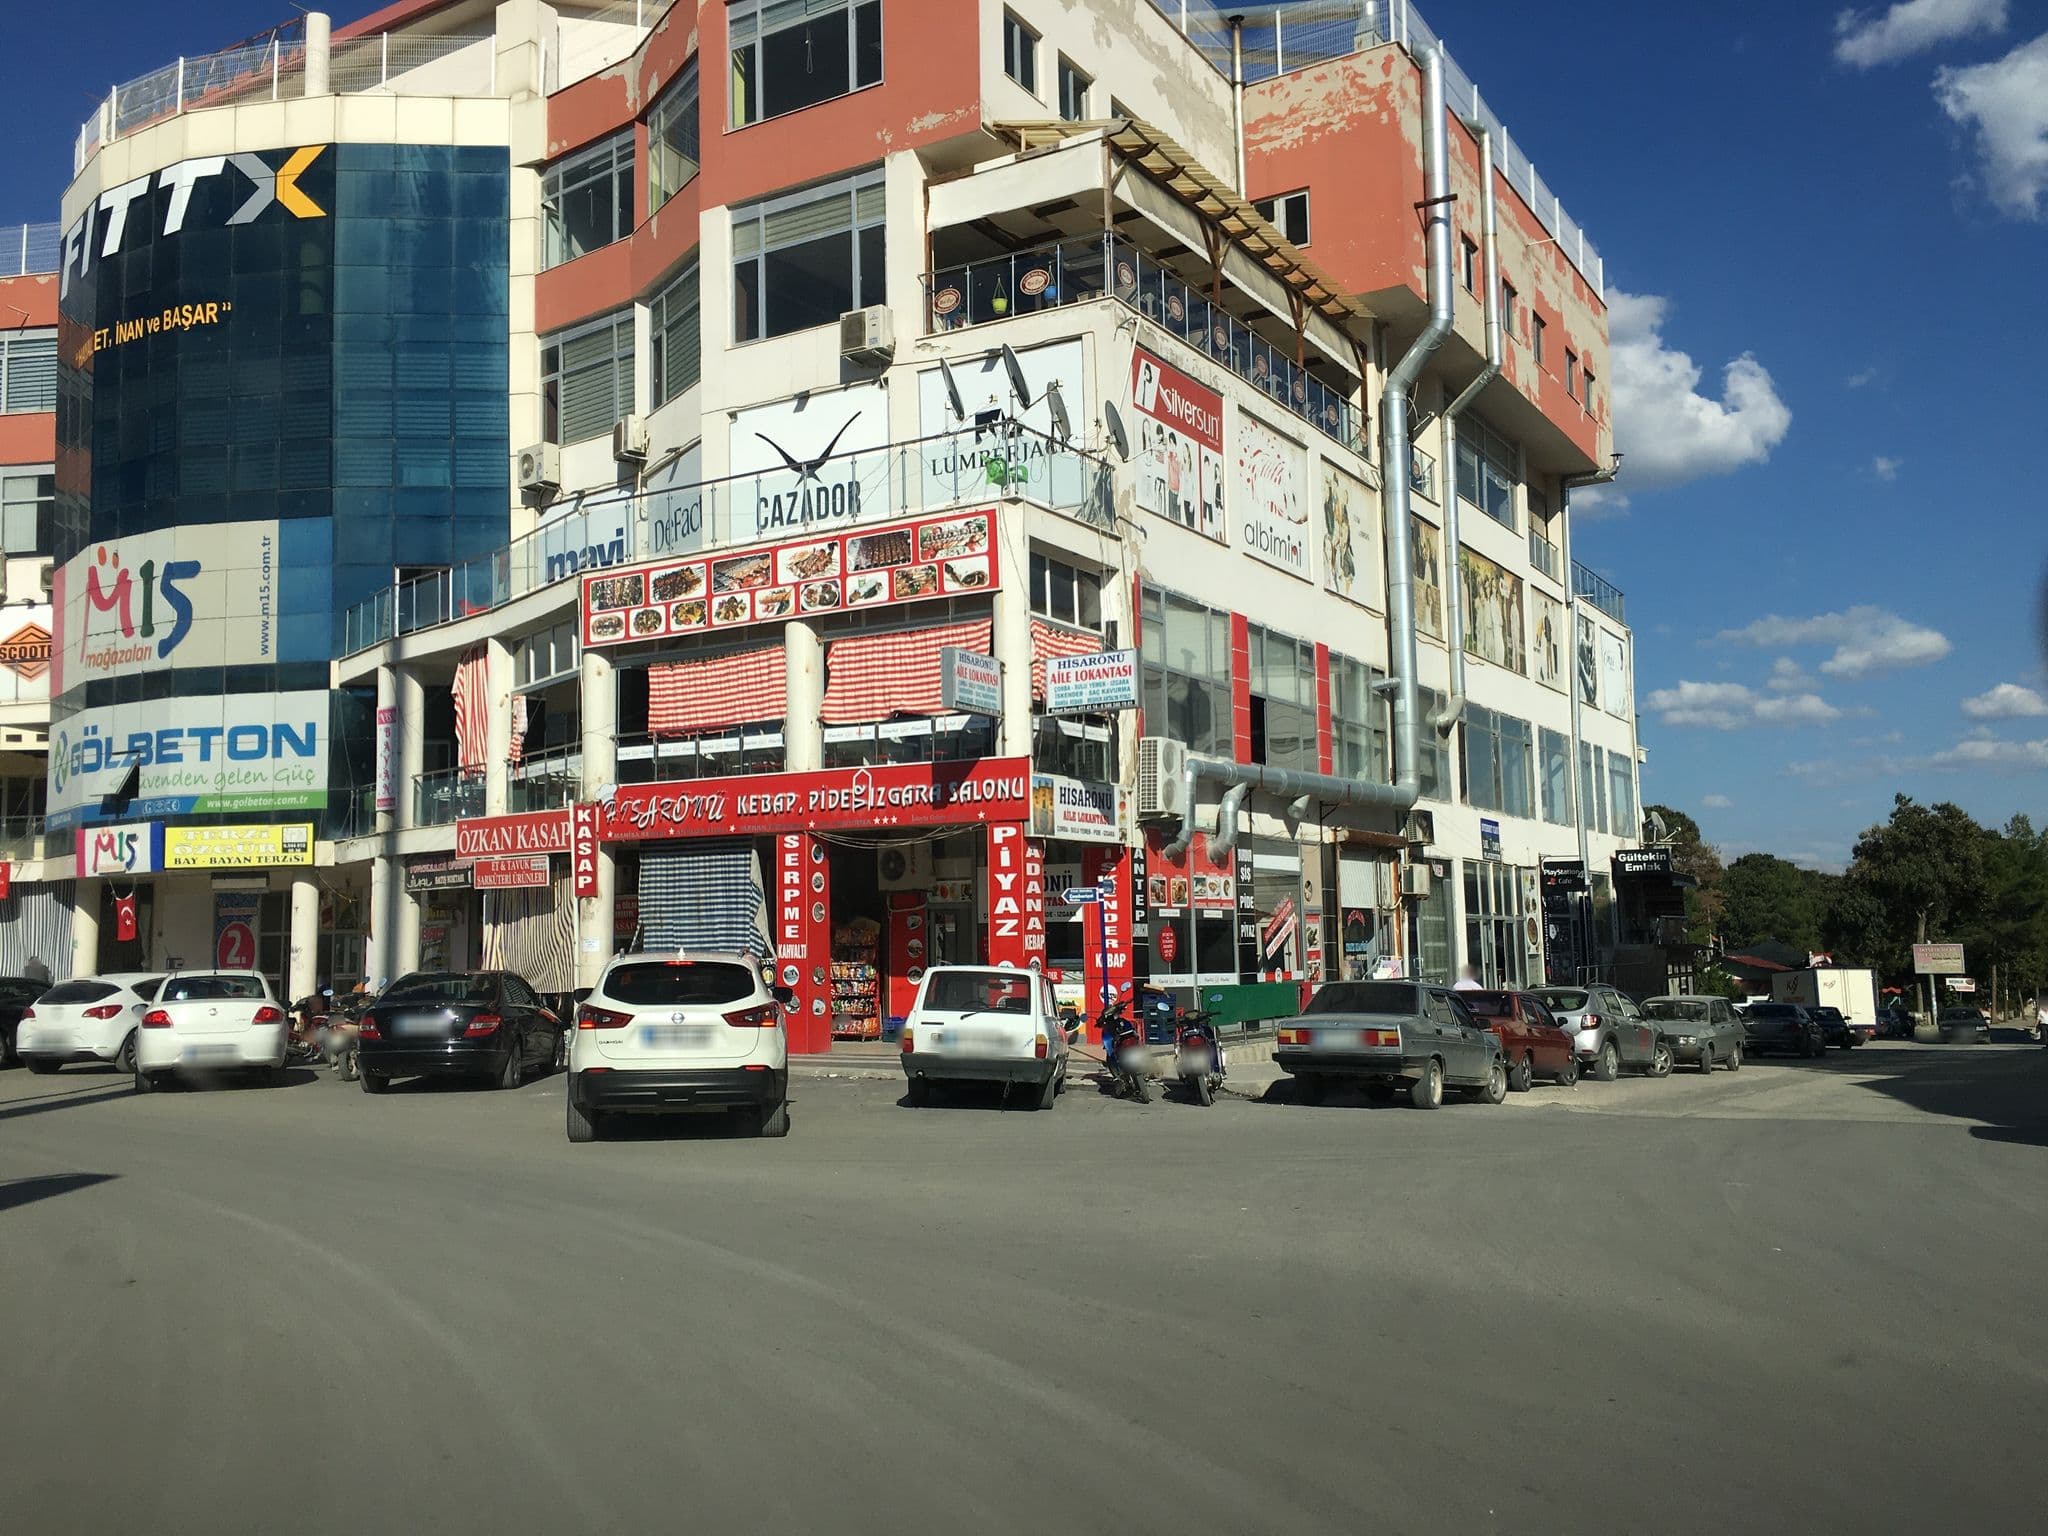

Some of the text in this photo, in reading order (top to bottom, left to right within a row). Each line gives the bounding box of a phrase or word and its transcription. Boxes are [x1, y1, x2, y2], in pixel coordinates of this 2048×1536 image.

[115, 318, 144, 345] İNAN
[147, 317, 160, 334] ve
[163, 302, 218, 331] BAŞAR
[1162, 386, 1219, 441] silversun
[756, 480, 861, 531] CAZADOR
[547, 527, 624, 583] mavi
[1244, 519, 1302, 568] albimini
[260, 535, 272, 656] www.m15.com.tr
[1050, 665, 1132, 685] AİLE LOKANTASI
[1057, 652, 1126, 670] HİSARÖNÜ
[70, 722, 316, 776] GÖLBETON
[1059, 782, 1112, 810] HİSARÖNÜ
[459, 820, 571, 855] ÖZKAN KASAP
[577, 808, 592, 889] KASAP
[1618, 852, 1667, 862] Gültekin
[174, 857, 197, 865] BAY
[993, 826, 1019, 936] PİYAZ
[1625, 862, 1661, 872] Emlak
[784, 835, 800, 939] SERPME
[1025, 846, 1043, 930] ADANA
[1024, 934, 1045, 951] KEBAP
[1095, 952, 1126, 968] KBAP
